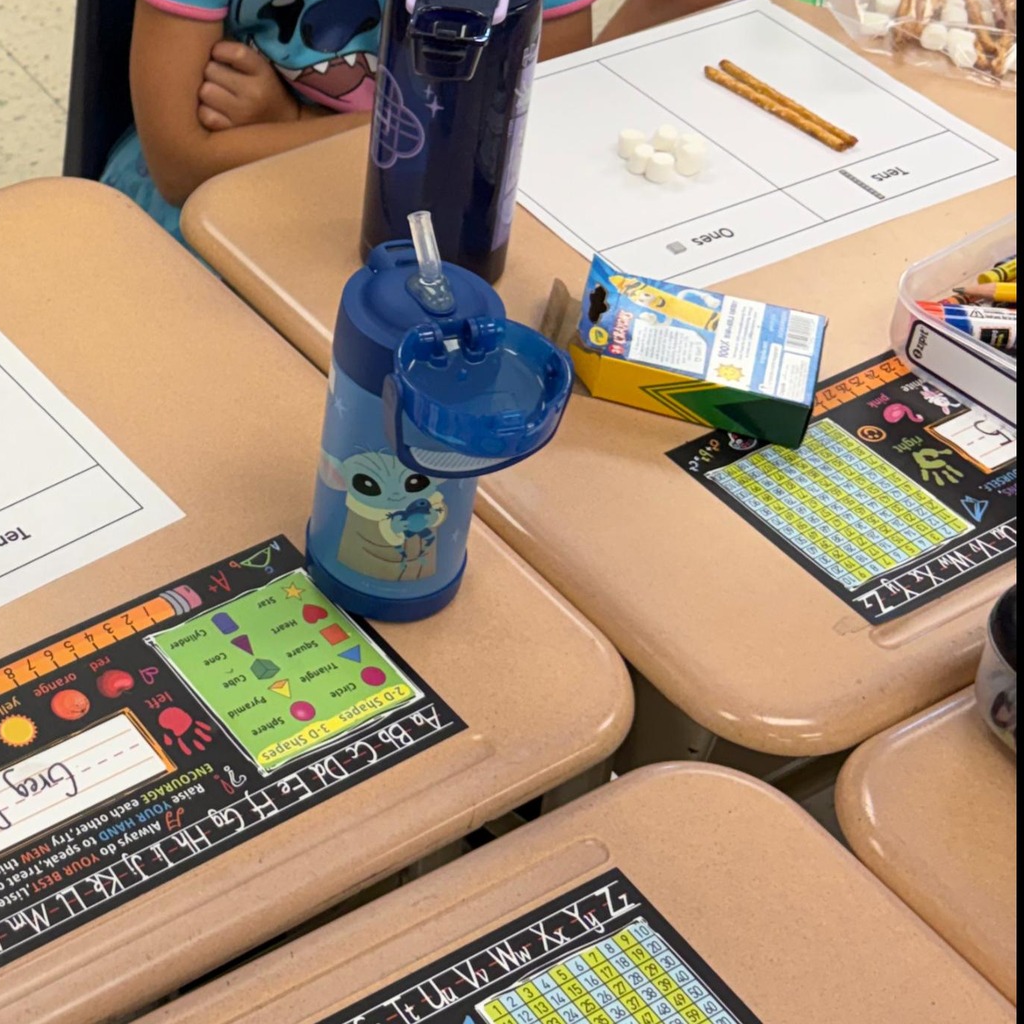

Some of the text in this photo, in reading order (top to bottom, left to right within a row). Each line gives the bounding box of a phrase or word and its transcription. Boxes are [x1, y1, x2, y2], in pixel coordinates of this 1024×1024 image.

[691, 166, 910, 246] Ones Tens
[867, 392, 890, 408] pink
[892, 435, 923, 453] right
[969, 539, 1002, 558] Vv
[937, 551, 977, 572] Ww
[254, 596, 276, 608] Star
[102, 622, 113, 635] 3
[120, 611, 133, 625] 2
[270, 619, 297, 637] Heart
[61, 638, 74, 652] 5
[84, 632, 93, 642] 4
[170, 629, 207, 649] Cylinder
[43, 649, 53, 660] 6
[204, 652, 227, 665] Cone
[282, 640, 318, 657] Square
[0, 665, 17, 681] 8
[26, 658, 35, 670] 7
[89, 656, 111, 671] red
[299, 662, 338, 682] Triangle
[29, 671, 76, 696] orange
[223, 672, 249, 691] Cube
[327, 680, 356, 700] Circle
[144, 690, 172, 712] left
[227, 696, 266, 718] Pyramid
[338, 686, 404, 723] 2-D Shapes
[251, 716, 284, 735] Sphere
[407, 706, 441, 729] Aa
[261, 723, 329, 760] 3-D Shapes
[377, 722, 413, 749] Bb
[344, 740, 377, 763] Cc
[2, 762, 78, 797] Greg
[307, 754, 349, 786] Dd
[140, 763, 213, 803] ENCOURAGE
[171, 780, 204, 802] Raise
[276, 772, 312, 799] Ee
[109, 799, 139, 817] each
[133, 797, 171, 822] YOUR
[243, 789, 278, 819] Ff
[94, 814, 138, 844] HAND
[206, 807, 245, 831] Gg
[82, 836, 96, 847] to
[117, 820, 161, 846] Always
[170, 824, 211, 853] Hh
[16, 840, 50, 866] NEW
[99, 843, 116, 855] do
[148, 842, 174, 866] Ii
[62, 853, 99, 875] YOUR
[120, 852, 148, 879] Jj
[84, 866, 125, 898] Kk
[54, 885, 87, 915] Ll
[4, 902, 50, 933] Mm
[382, 886, 636, 1024] Tt Uu Vv Ww Xx Yy Zz
[490, 924, 651, 1015] 1 2 3 4 5 6 7 8 9 10
